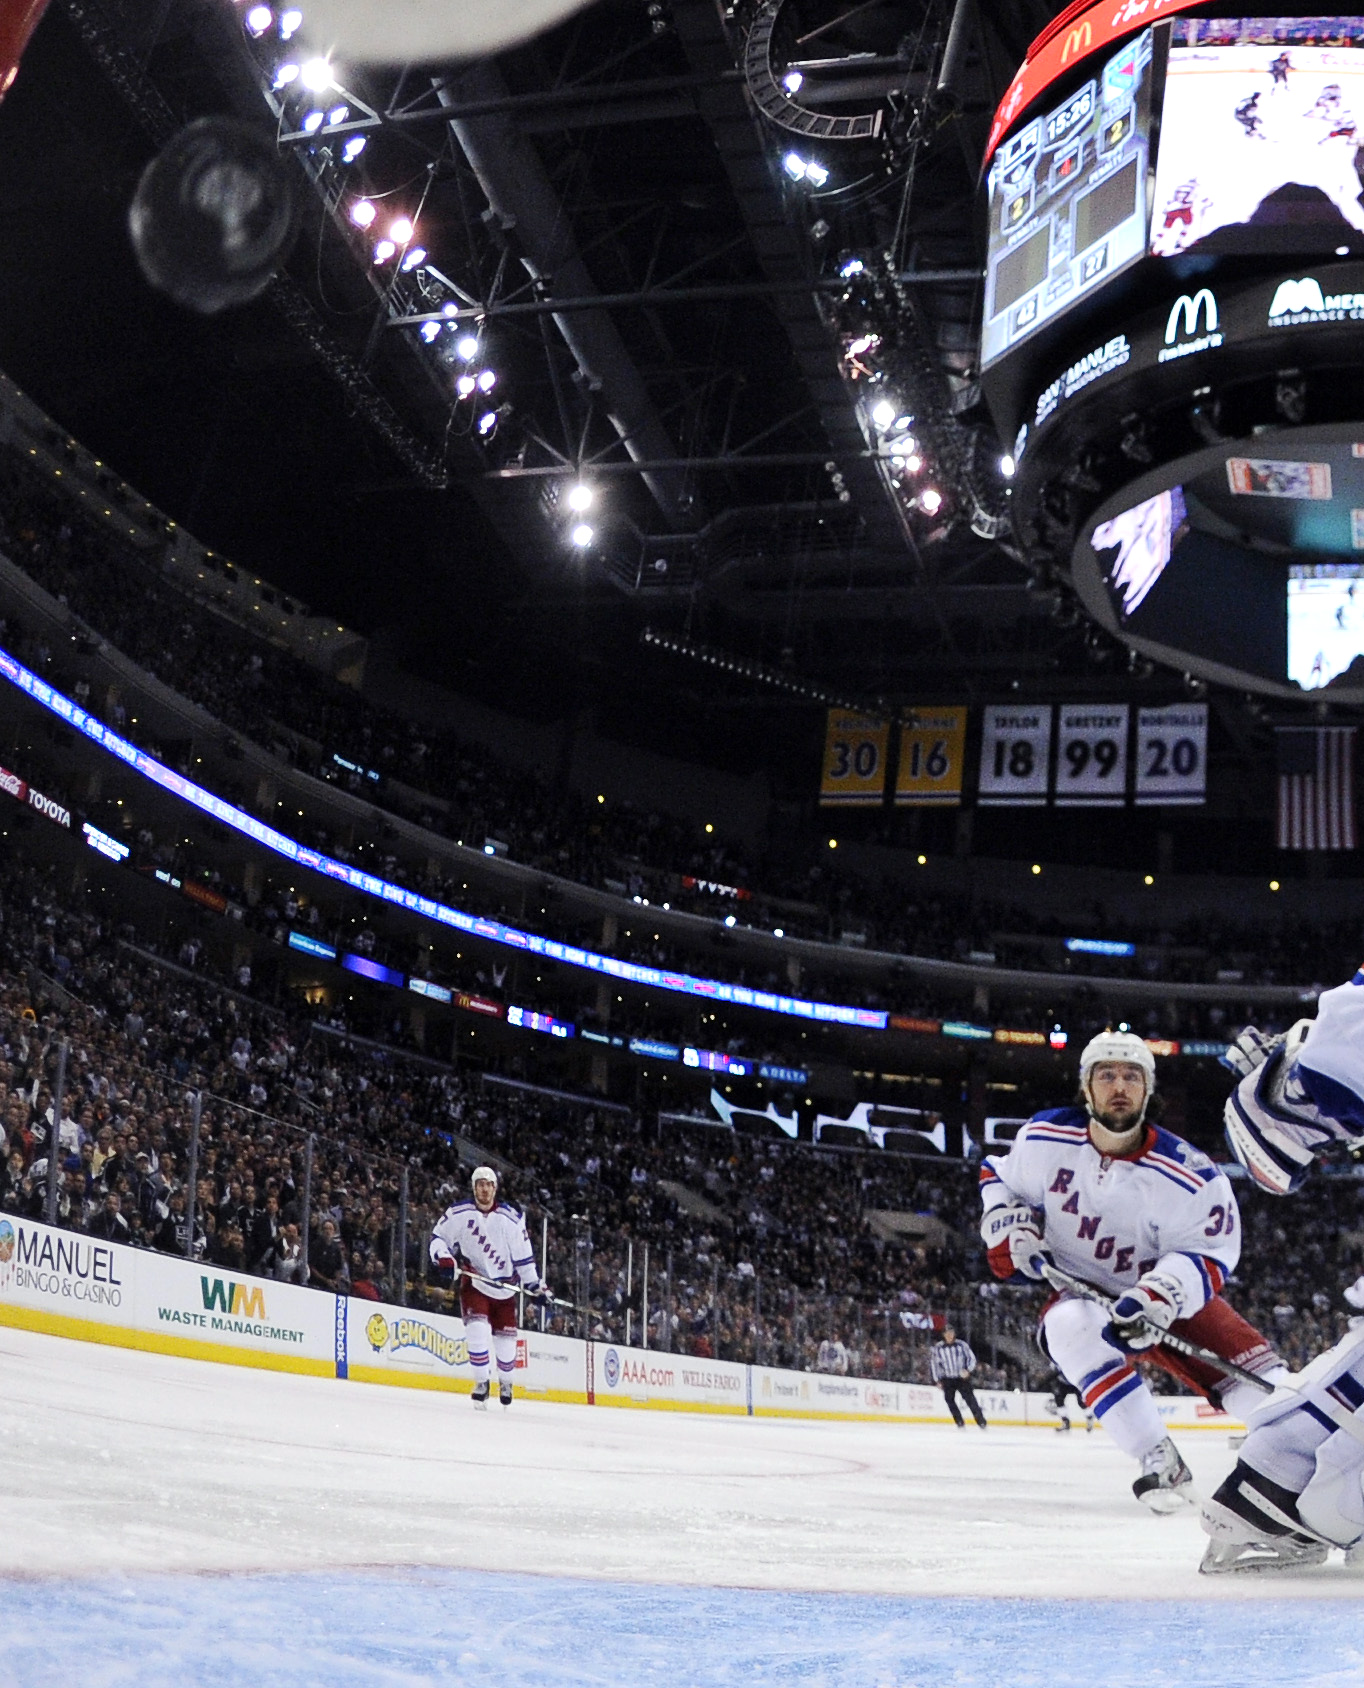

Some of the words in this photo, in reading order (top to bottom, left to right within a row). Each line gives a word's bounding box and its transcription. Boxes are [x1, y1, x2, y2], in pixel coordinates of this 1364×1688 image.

[1049, 93, 1091, 140] 15:26
[1111, 120, 1123, 143] 2
[1011, 197, 1024, 221] 2
[1085, 250, 1106, 280] 27
[1017, 300, 1036, 326] 42
[1268, 309, 1346, 327] INSURANCE
[1065, 334, 1131, 386] MANUEL
[829, 740, 879, 780] 30
[909, 740, 950, 780] 16
[994, 739, 1035, 779] 18
[1065, 738, 1119, 779] 99
[1145, 737, 1199, 778] 20
[29, 788, 71, 828] TOYOTA
[991, 1212, 1038, 1235] BAU
[1049, 1168, 1158, 1280] RANGER
[17, 1227, 122, 1286] MANUEL
[16, 1267, 60, 1295] BINGO
[61, 1278, 72, 1298] &
[74, 1280, 122, 1307] CASINO
[158, 1306, 207, 1328] WASTE
[211, 1316, 305, 1344] MANAGEMENT
[336, 1295, 346, 1362] Reebok
[622, 1359, 675, 1387] AAA.com
[682, 1369, 712, 1390] WELLS
[713, 1373, 741, 1392] FARGO
